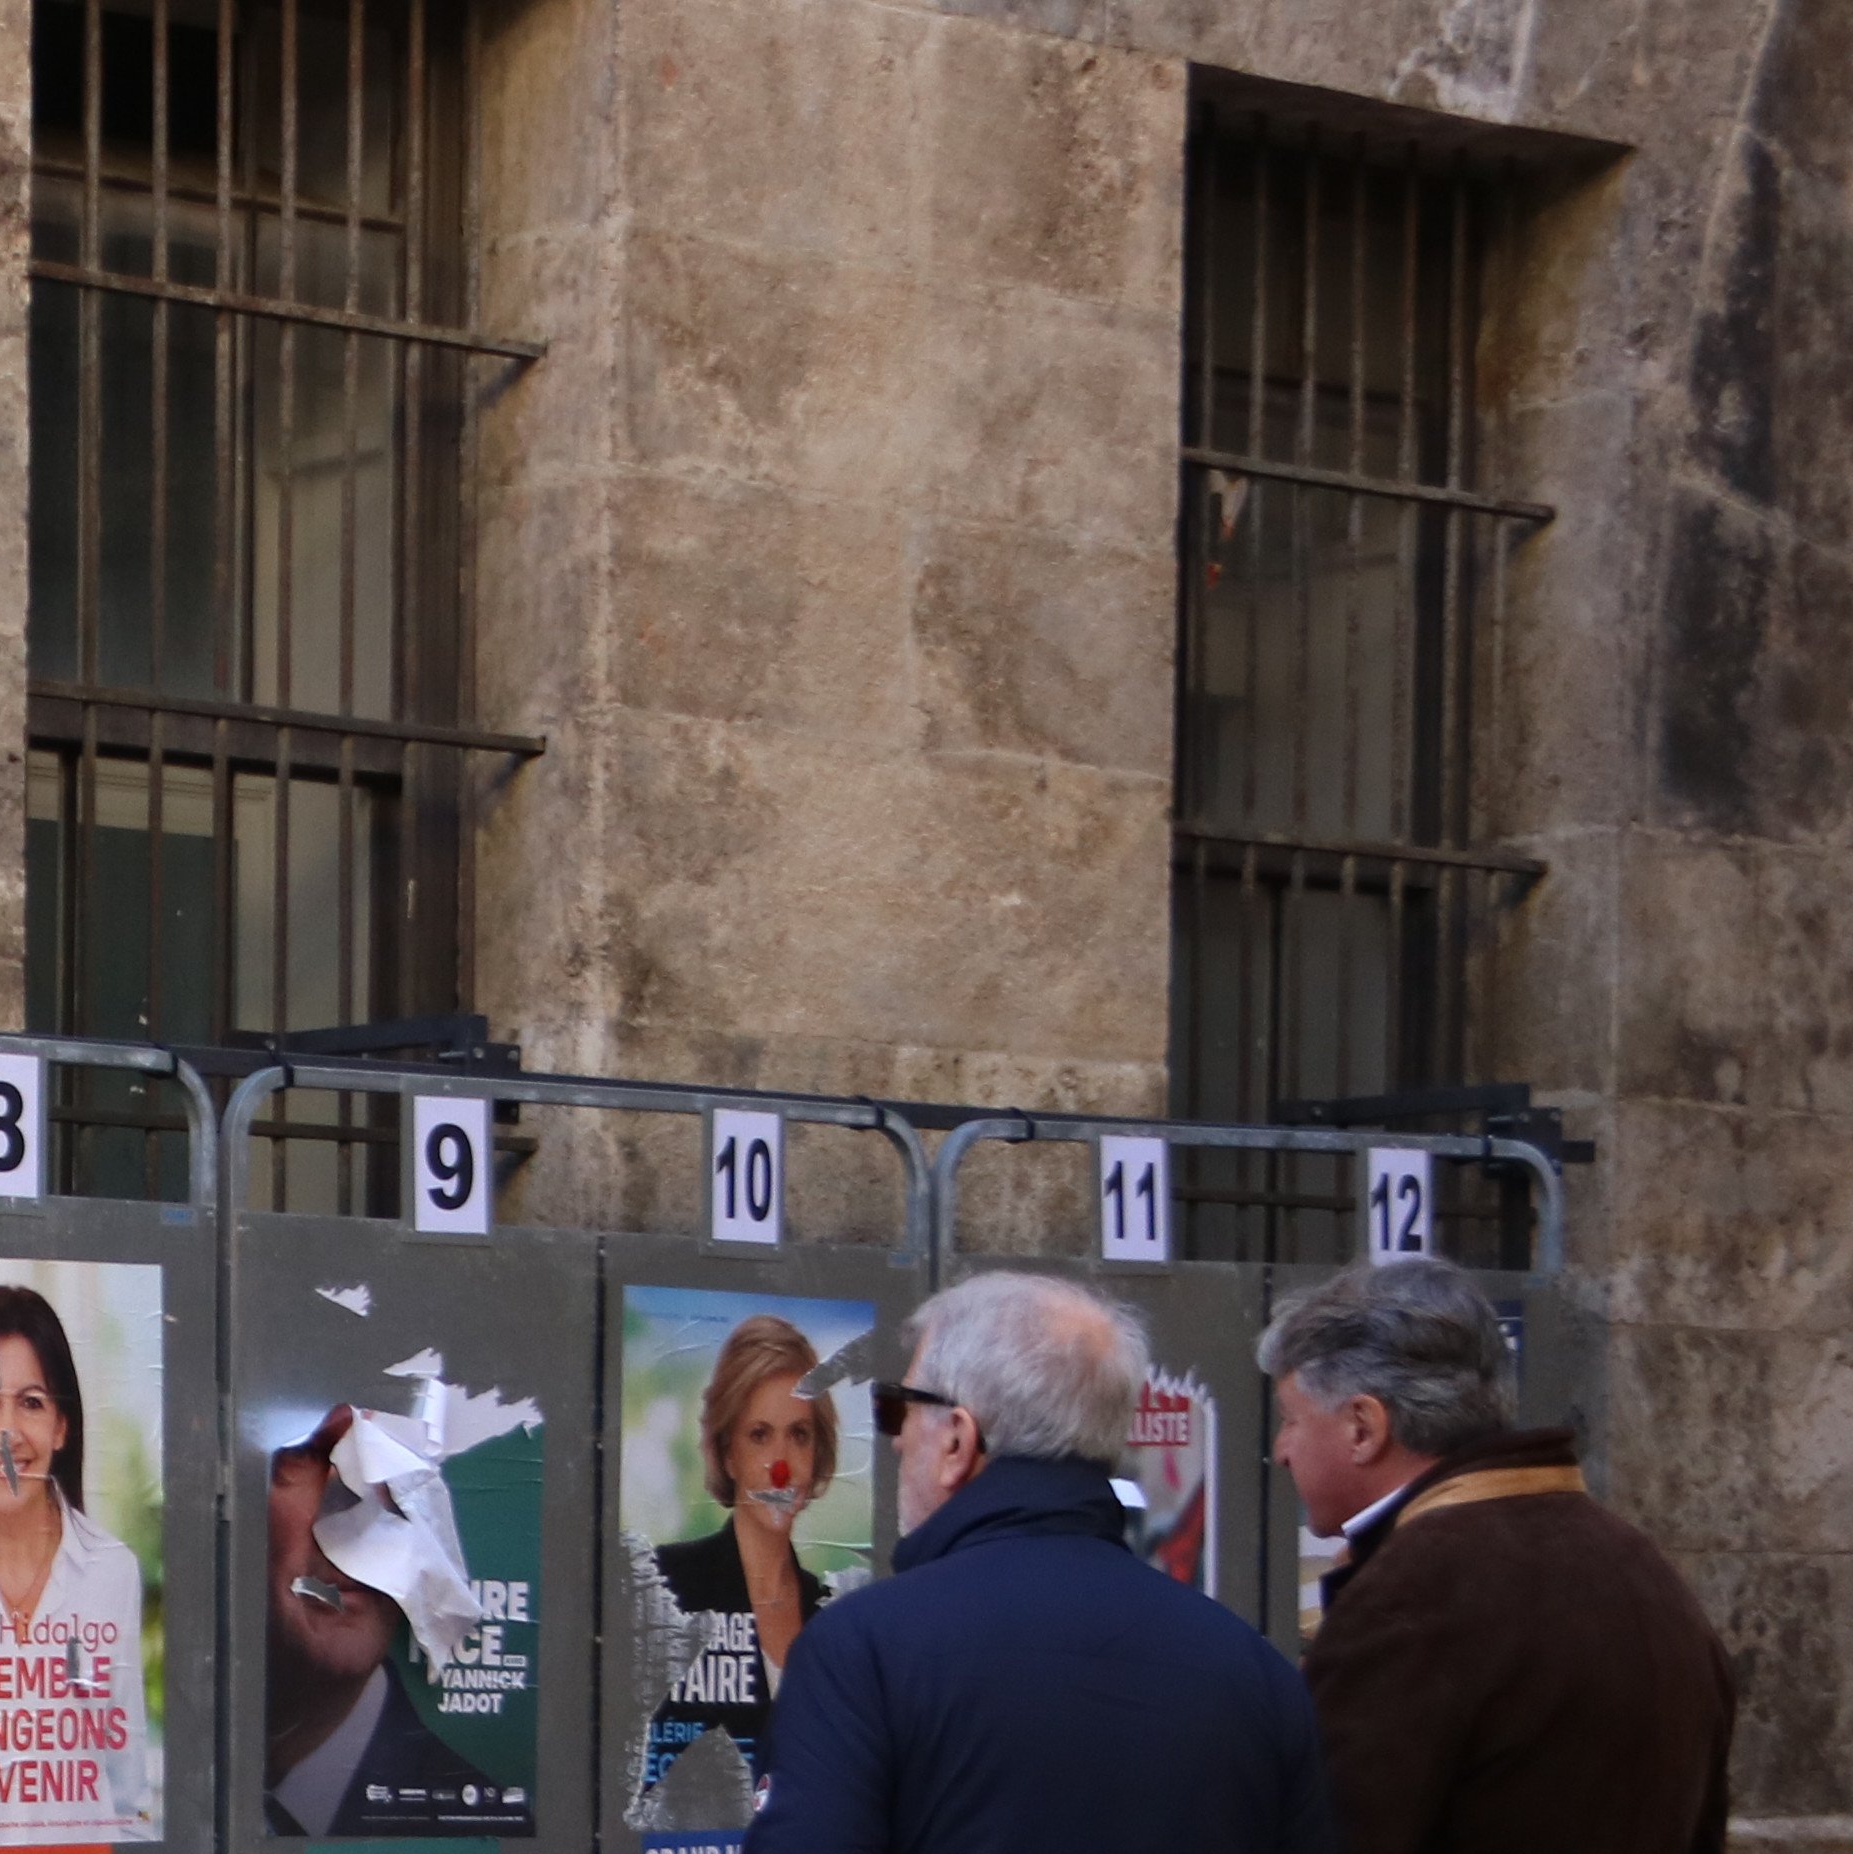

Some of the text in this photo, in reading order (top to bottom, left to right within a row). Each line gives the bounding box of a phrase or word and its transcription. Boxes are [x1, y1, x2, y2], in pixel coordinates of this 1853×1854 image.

[425, 1123, 474, 1210] 9
[715, 1136, 773, 1222] 10
[1104, 1159, 1156, 1241] 11
[1370, 1172, 1423, 1252] 12
[0, 1614, 118, 1653] Hidalgo
[437, 1692, 503, 1714] JADOT
[442, 1668, 525, 1689] YANNICK
